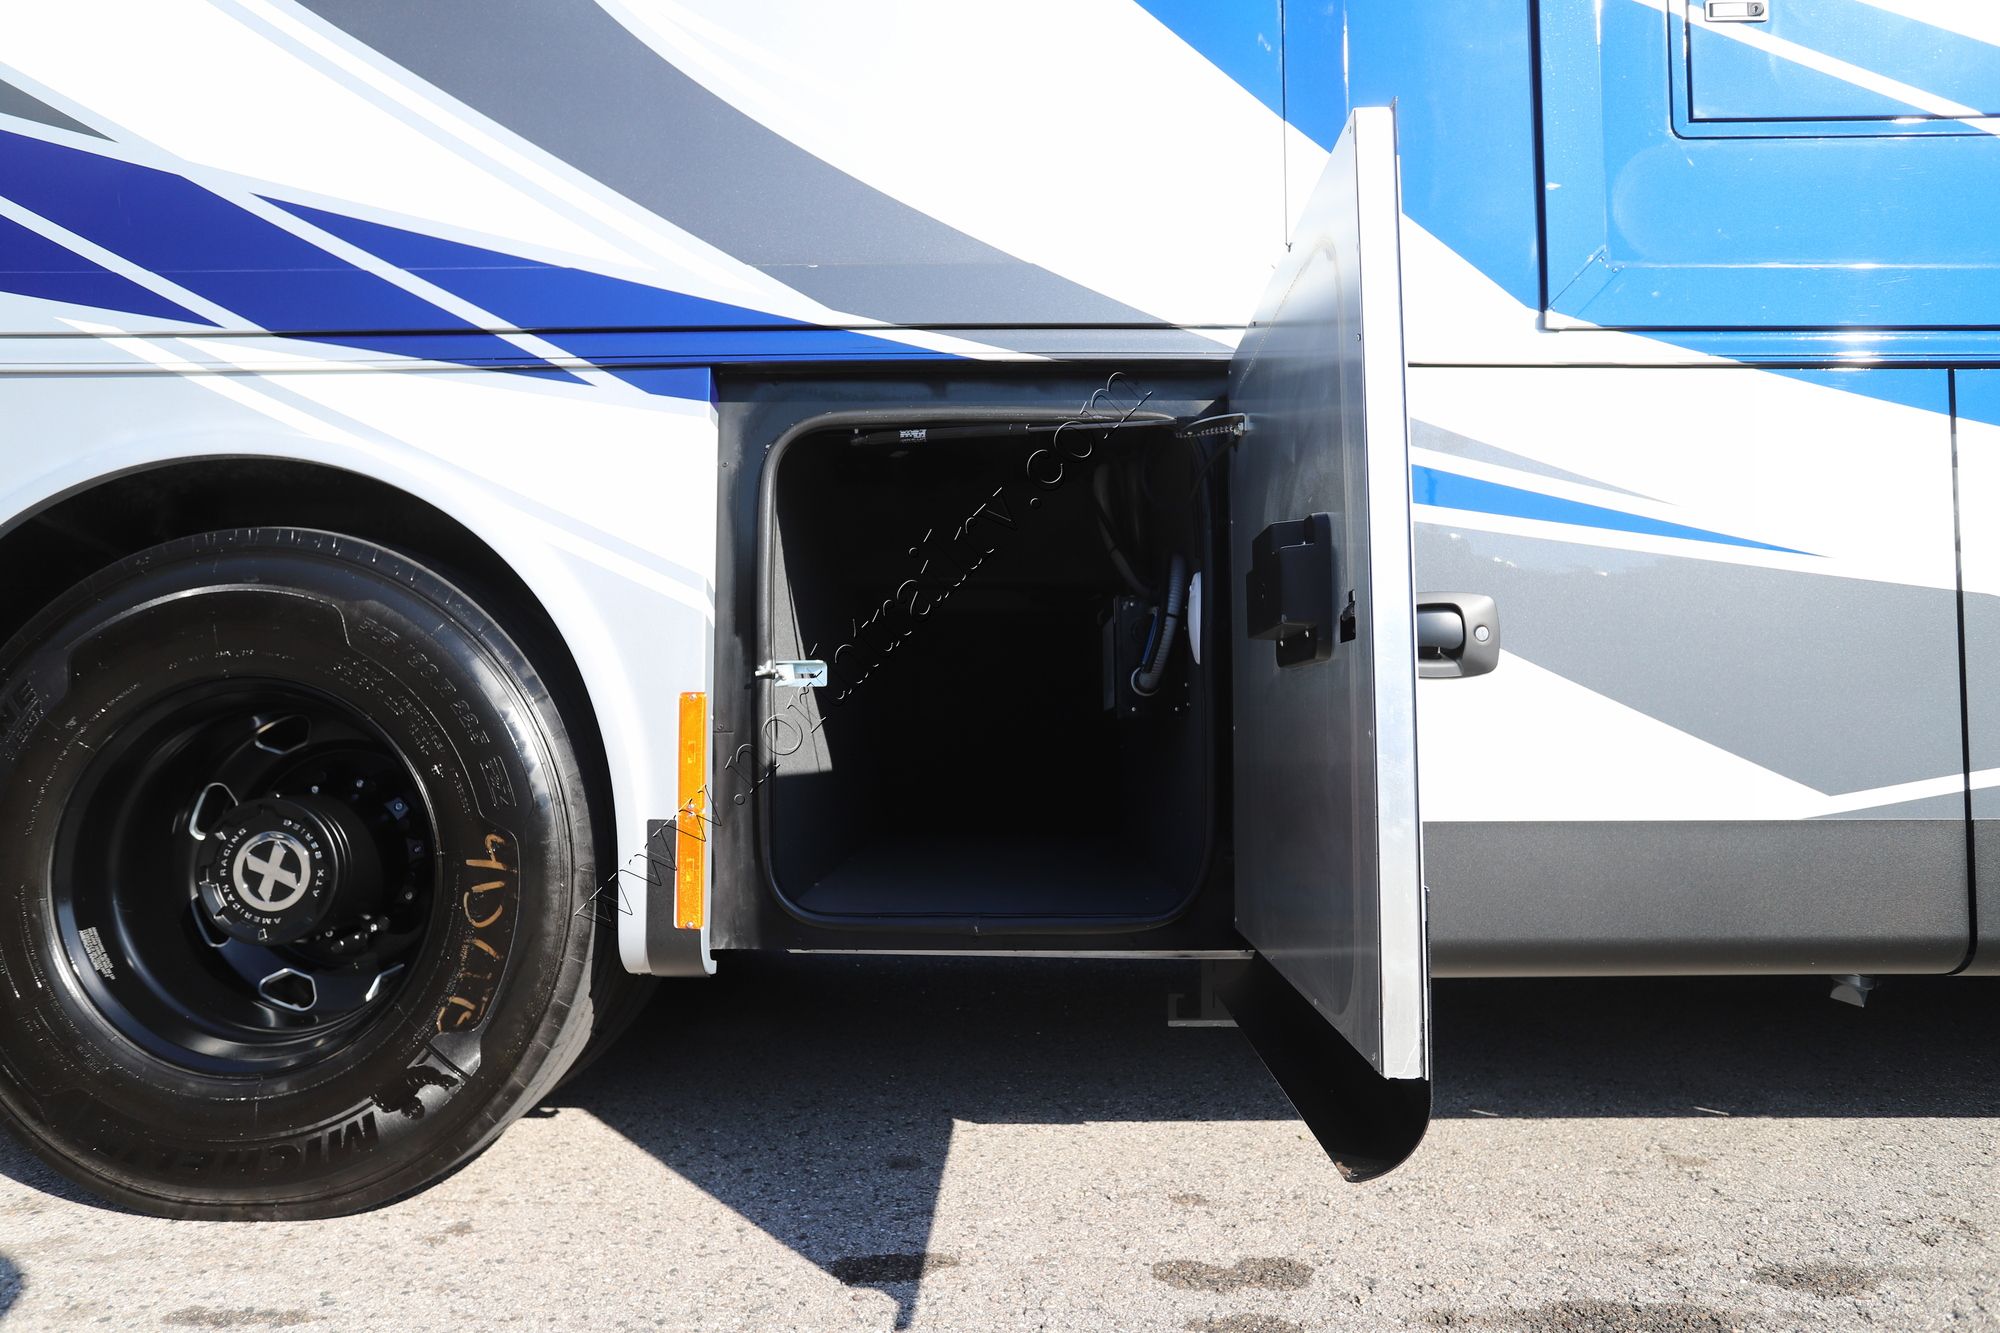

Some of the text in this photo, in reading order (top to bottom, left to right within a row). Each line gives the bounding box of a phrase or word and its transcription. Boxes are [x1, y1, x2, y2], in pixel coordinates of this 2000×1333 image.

[219, 827, 282, 924] AMERICAN RACING
[282, 819, 325, 898] ATX SERIES
